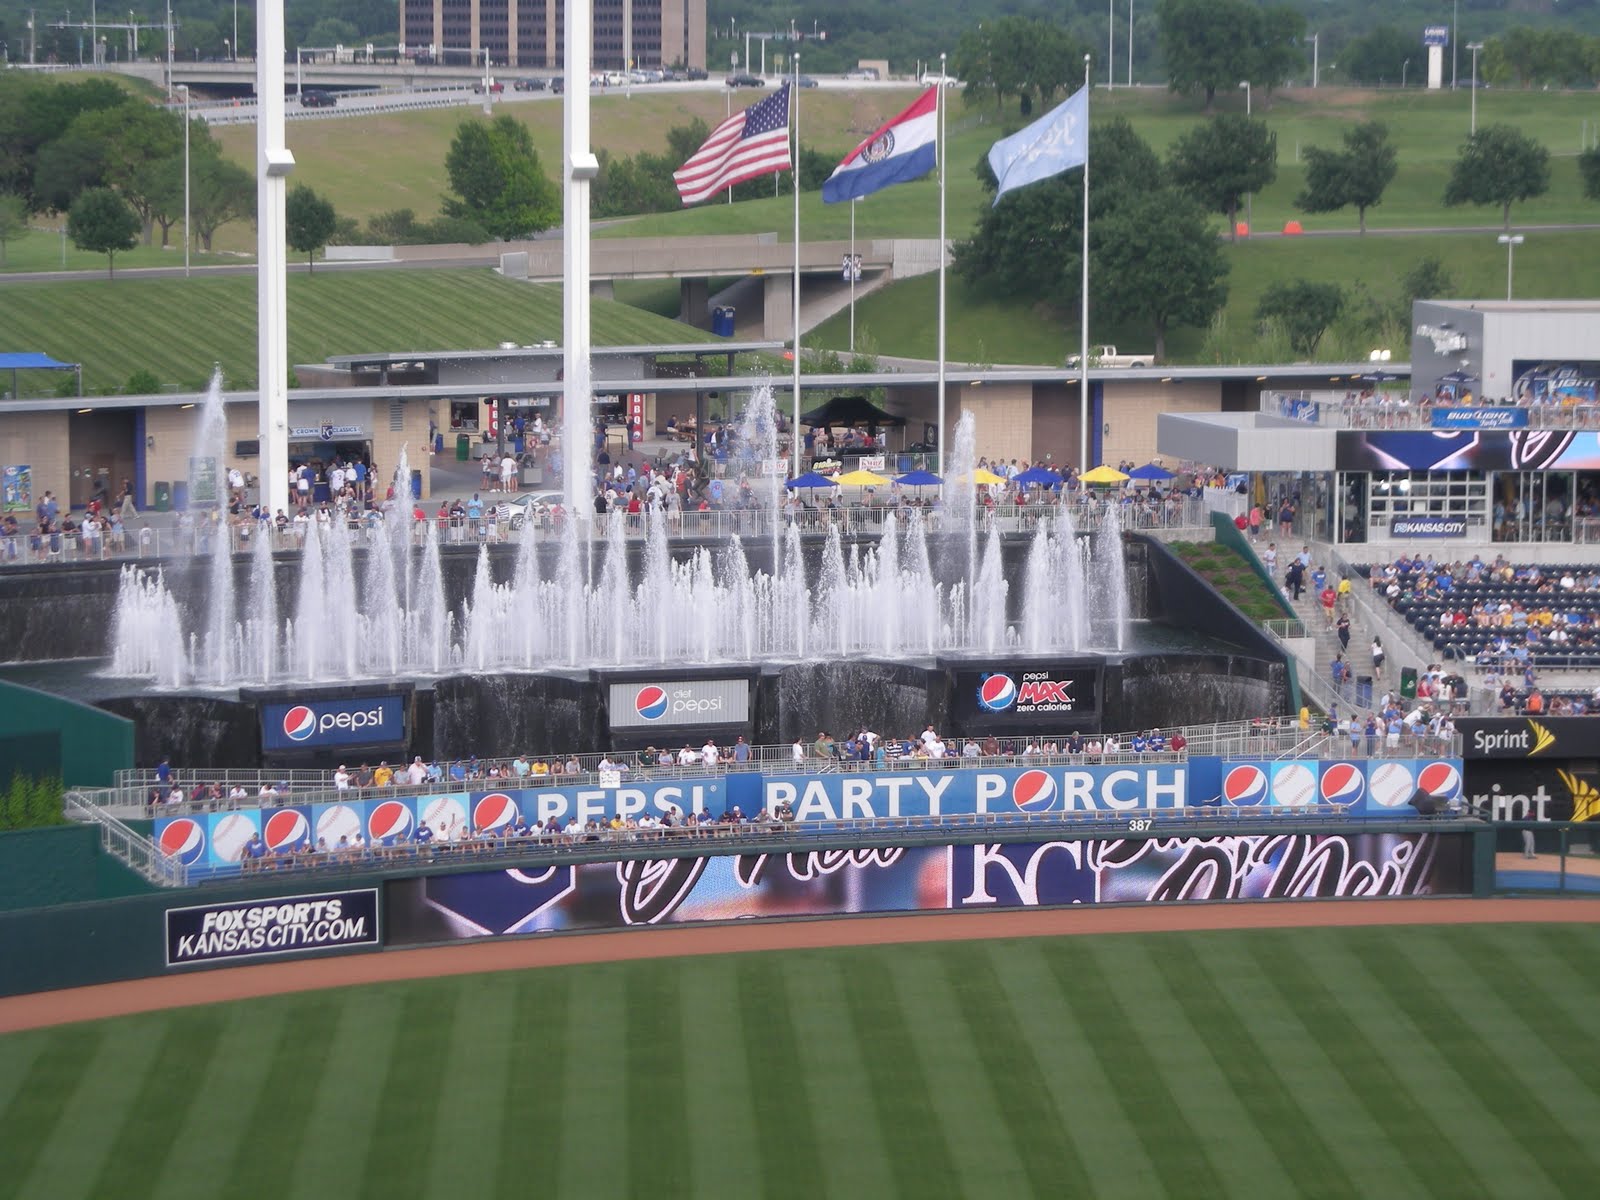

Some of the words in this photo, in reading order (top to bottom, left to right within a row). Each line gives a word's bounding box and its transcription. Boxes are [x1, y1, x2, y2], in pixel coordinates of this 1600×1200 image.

[633, 394, 641, 425] BBQ
[1447, 411, 1473, 420] BUD
[1474, 411, 1509, 420] LIGHT
[1444, 522, 1465, 533] CITY
[1022, 671, 1049, 681] pepsi
[673, 689, 692, 699] diet
[1017, 680, 1074, 704] MAX
[673, 696, 722, 714] pepsi
[1016, 704, 1036, 712] zero
[1037, 702, 1072, 712] calories
[320, 706, 383, 734] pepsi
[1474, 729, 1529, 754] Sprint
[537, 785, 705, 831] PEPSI
[766, 775, 954, 823] PARTY
[1462, 783, 1552, 822] rint
[1129, 819, 1152, 831] 387
